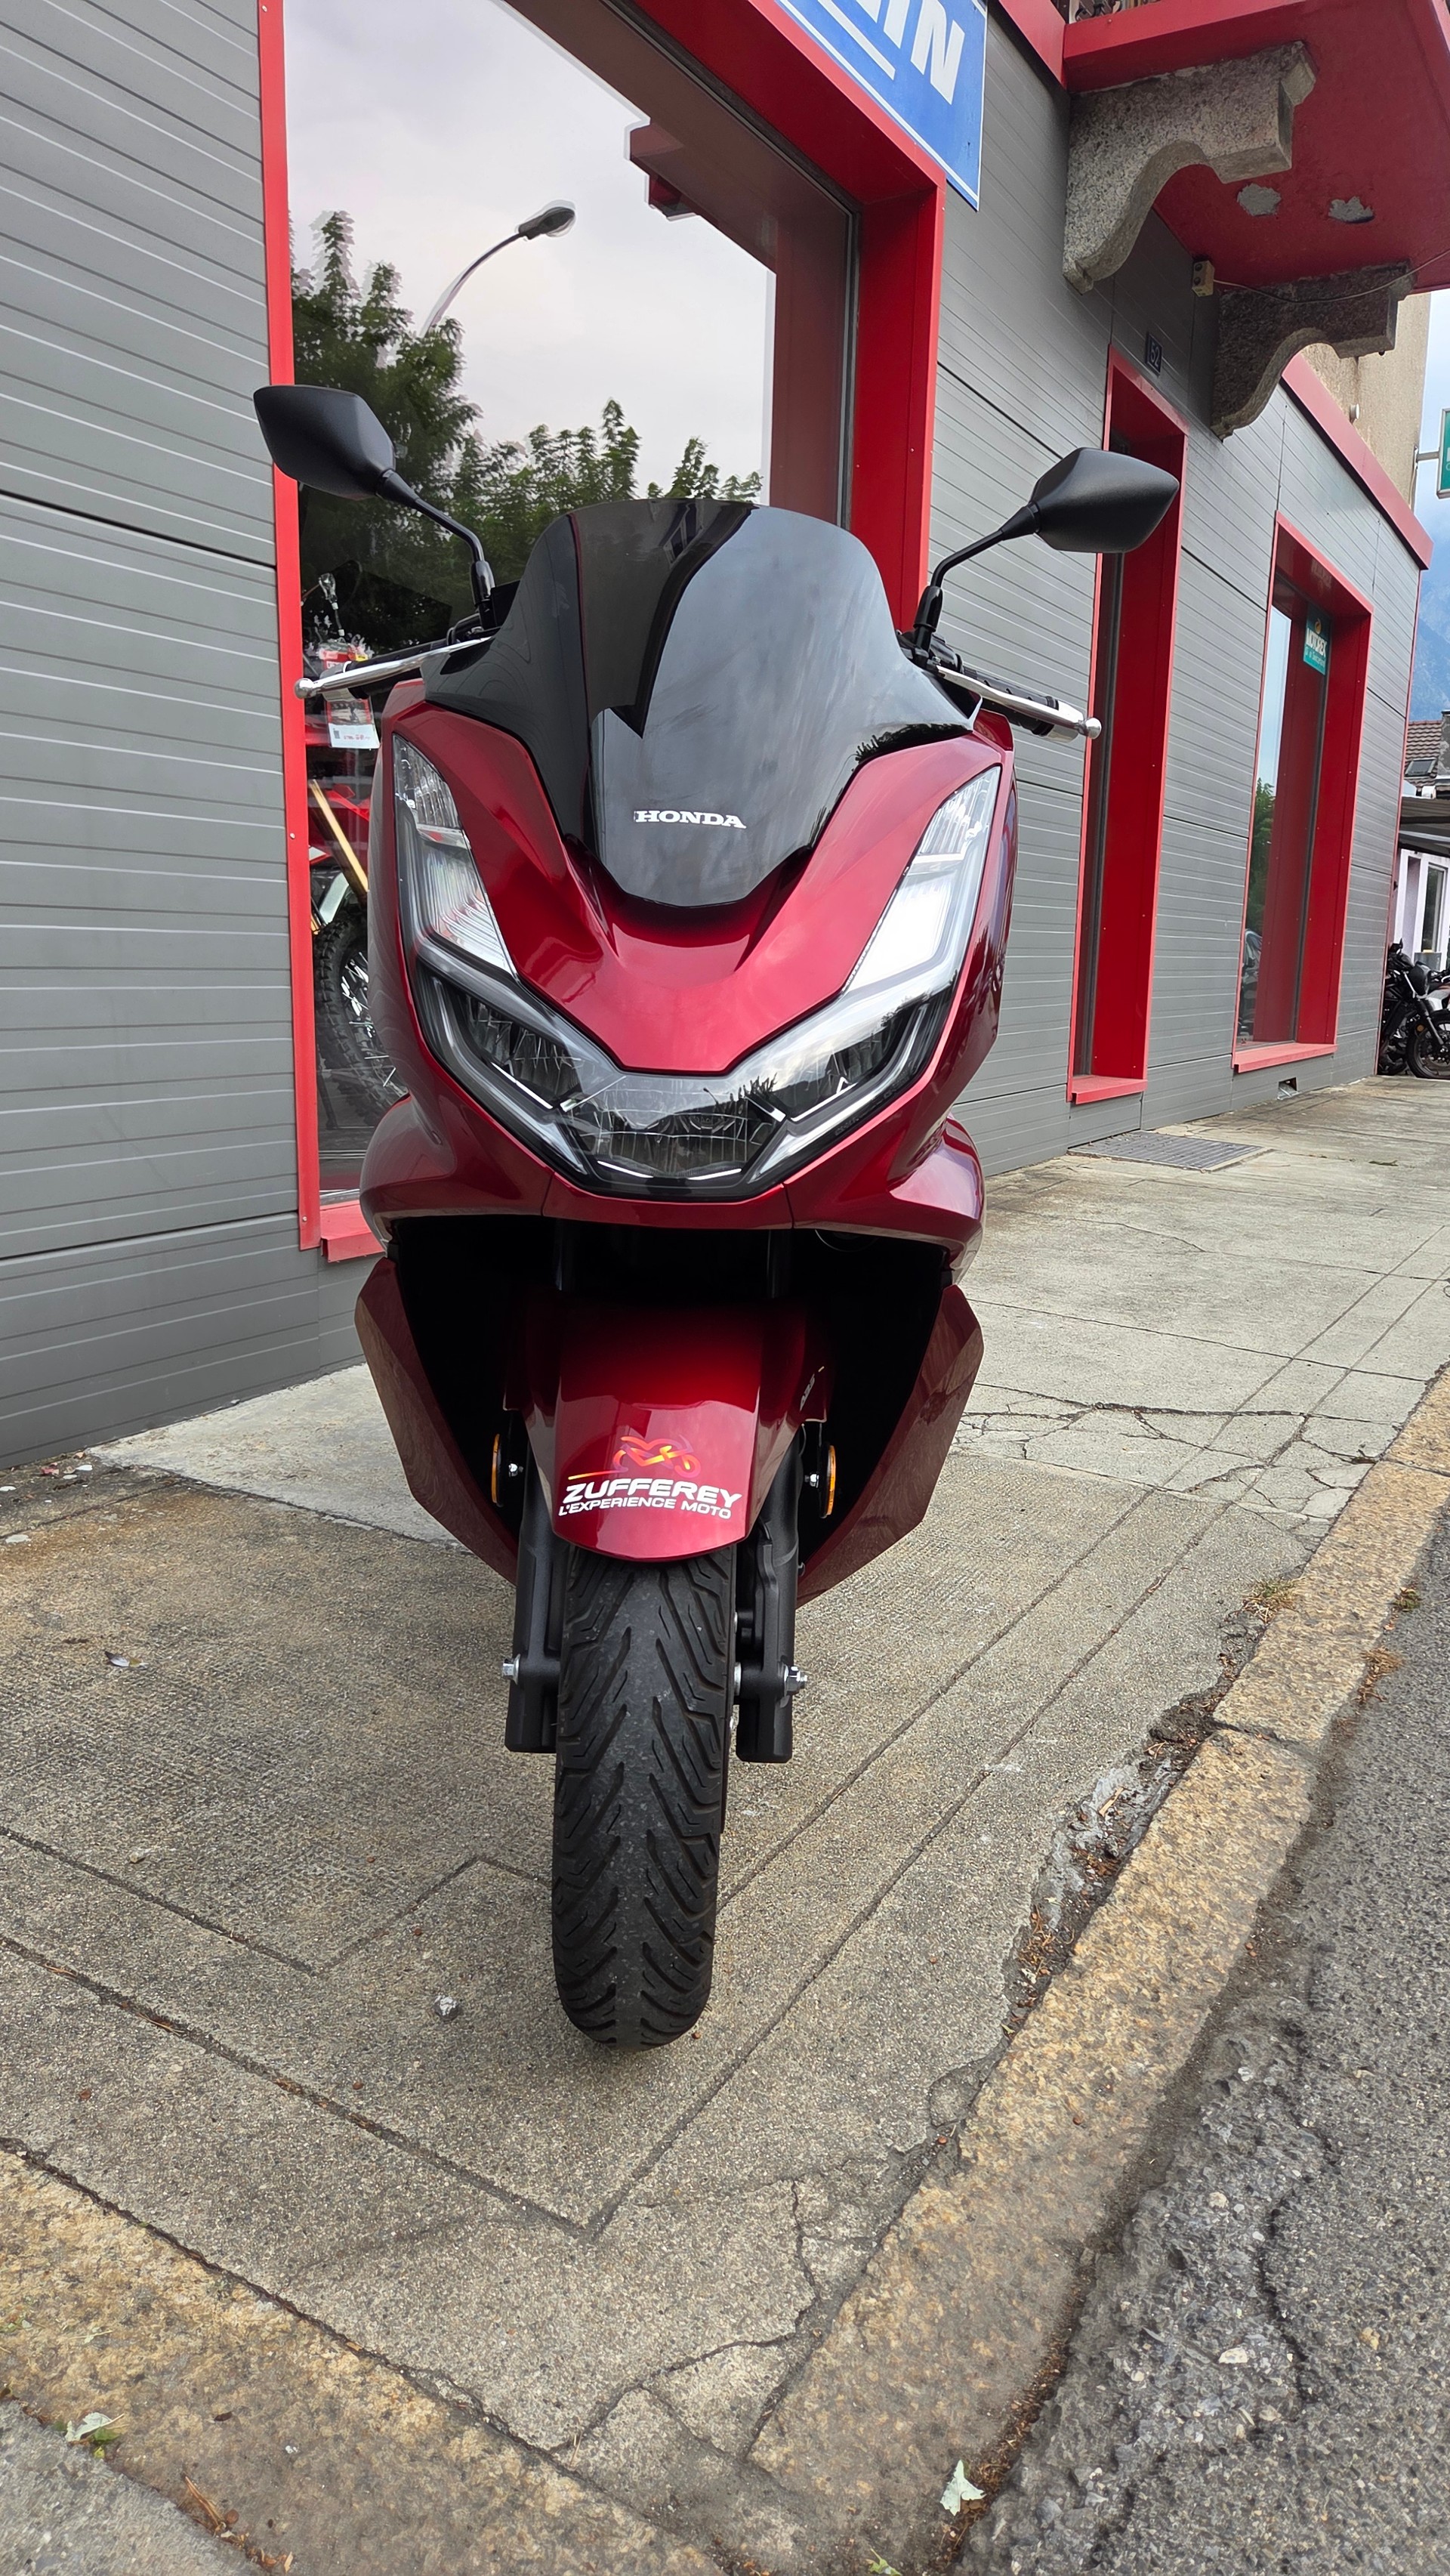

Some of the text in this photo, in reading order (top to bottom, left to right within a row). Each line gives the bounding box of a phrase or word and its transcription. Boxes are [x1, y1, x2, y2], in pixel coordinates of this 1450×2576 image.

[856, 0, 965, 105] IN
[1150, 341, 1161, 368] 52
[634, 811, 747, 829] HONDA
[563, 1478, 742, 1508] ZUFFEREY
[559, 1496, 732, 1520] L'EXPERIENCE MOTO
